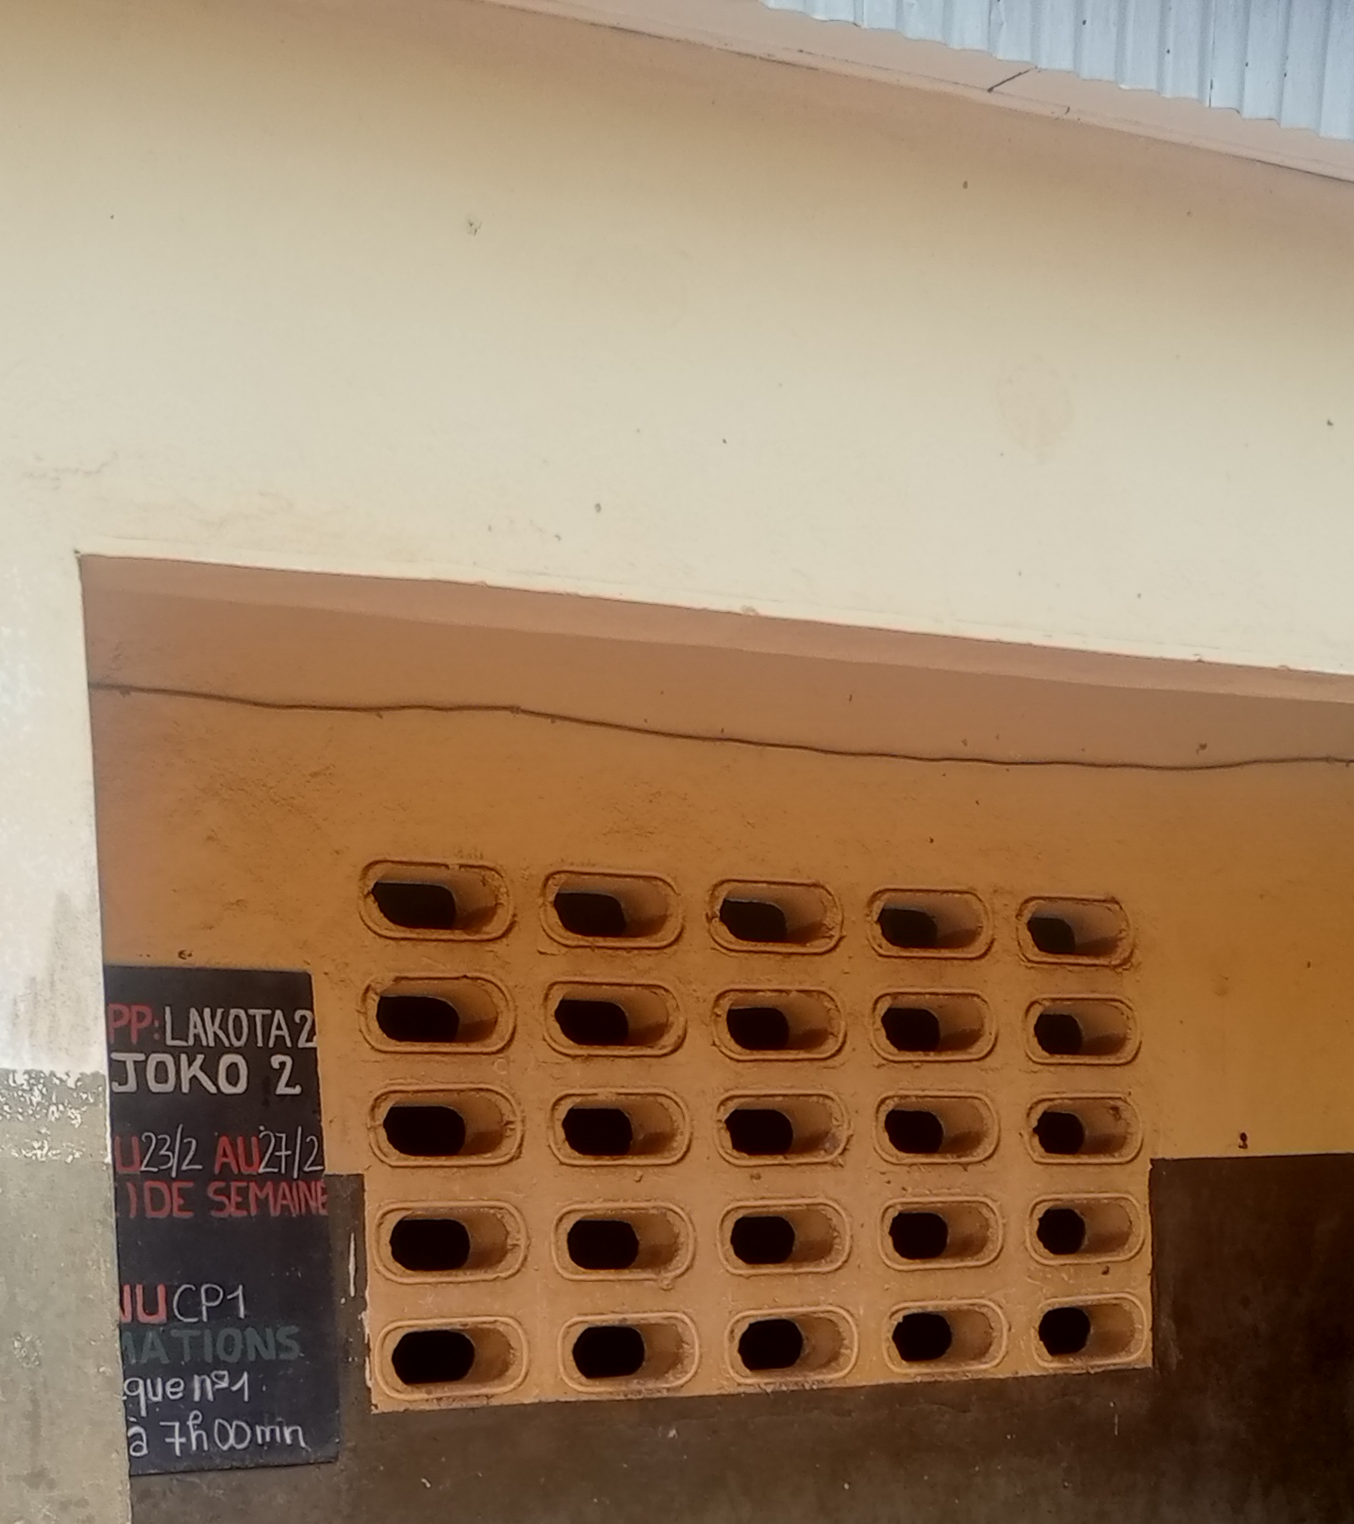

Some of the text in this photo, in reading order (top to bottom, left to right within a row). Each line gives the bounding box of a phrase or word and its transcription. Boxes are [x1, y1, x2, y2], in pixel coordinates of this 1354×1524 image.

[270, 1054, 302, 1095] 2
[207, 1180, 329, 1218] SEMAINE
[173, 1283, 246, 1323] CP1
